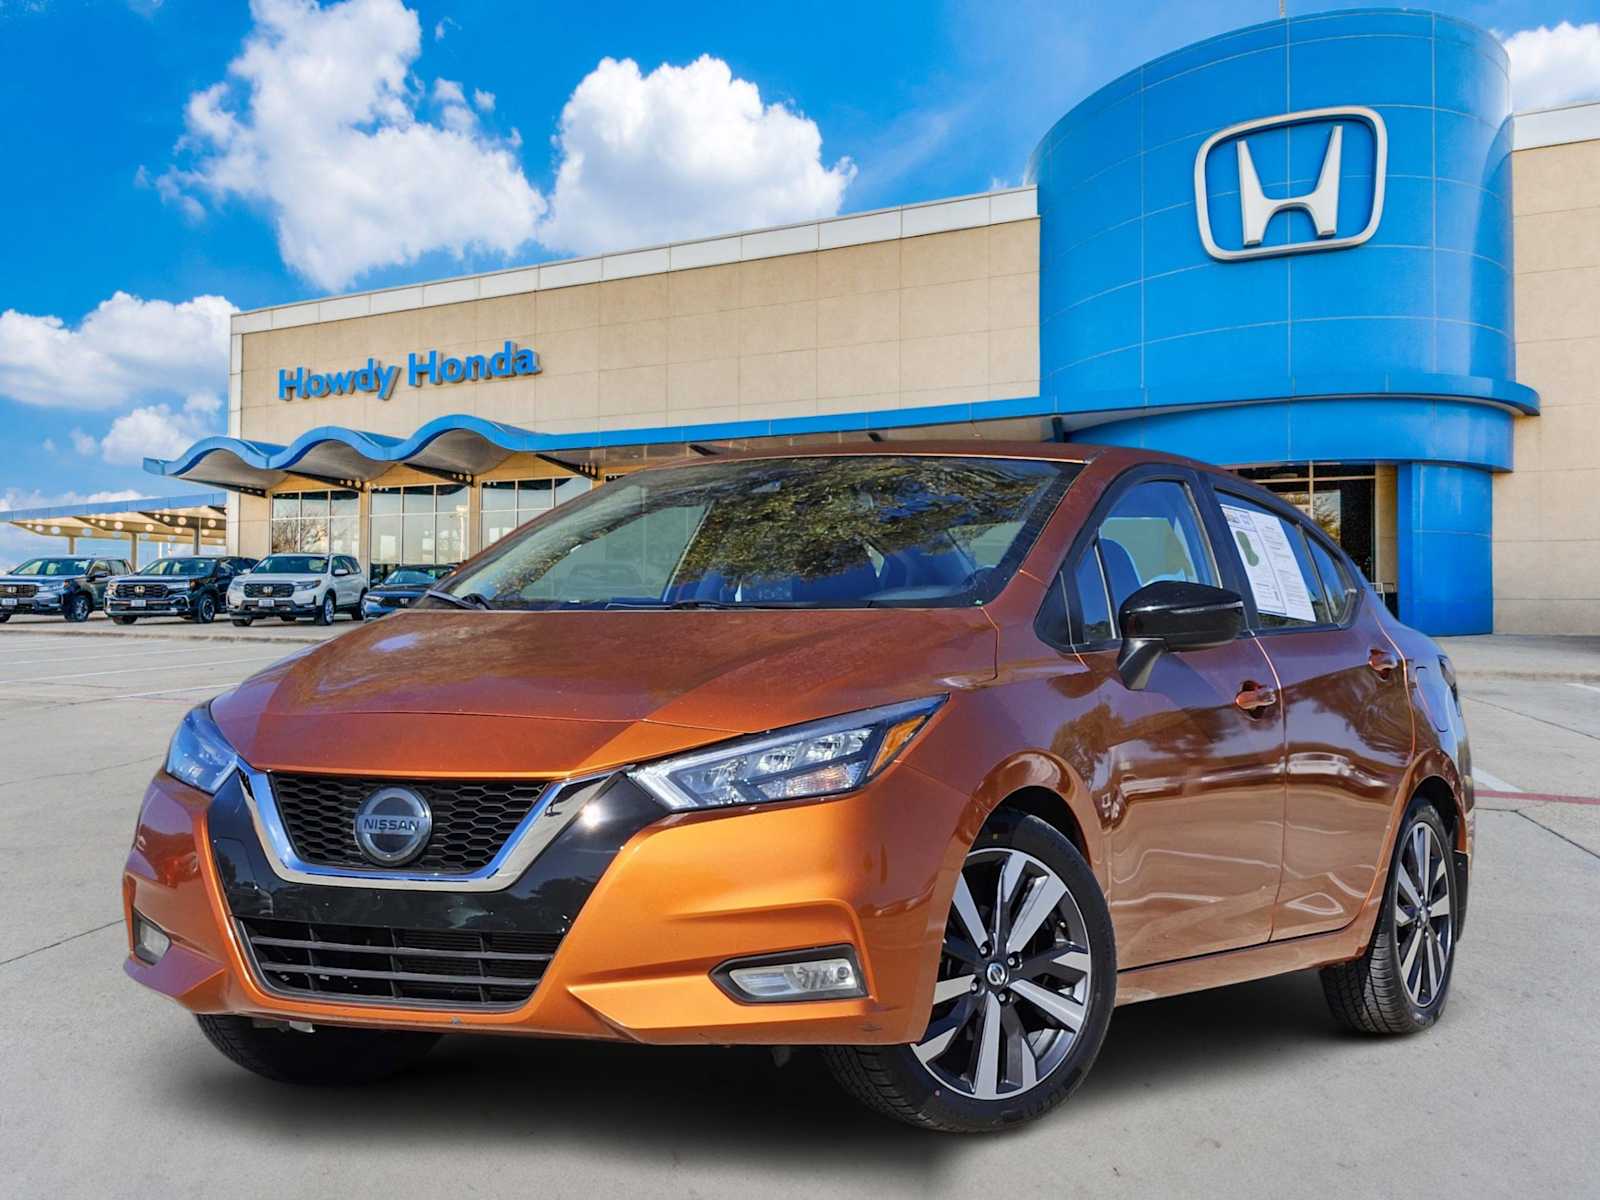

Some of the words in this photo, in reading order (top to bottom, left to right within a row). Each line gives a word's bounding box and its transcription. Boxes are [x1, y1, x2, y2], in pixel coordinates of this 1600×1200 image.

[278, 357, 401, 401] Howdy
[407, 340, 542, 388] Honda
[364, 819, 420, 831] NISSAN
